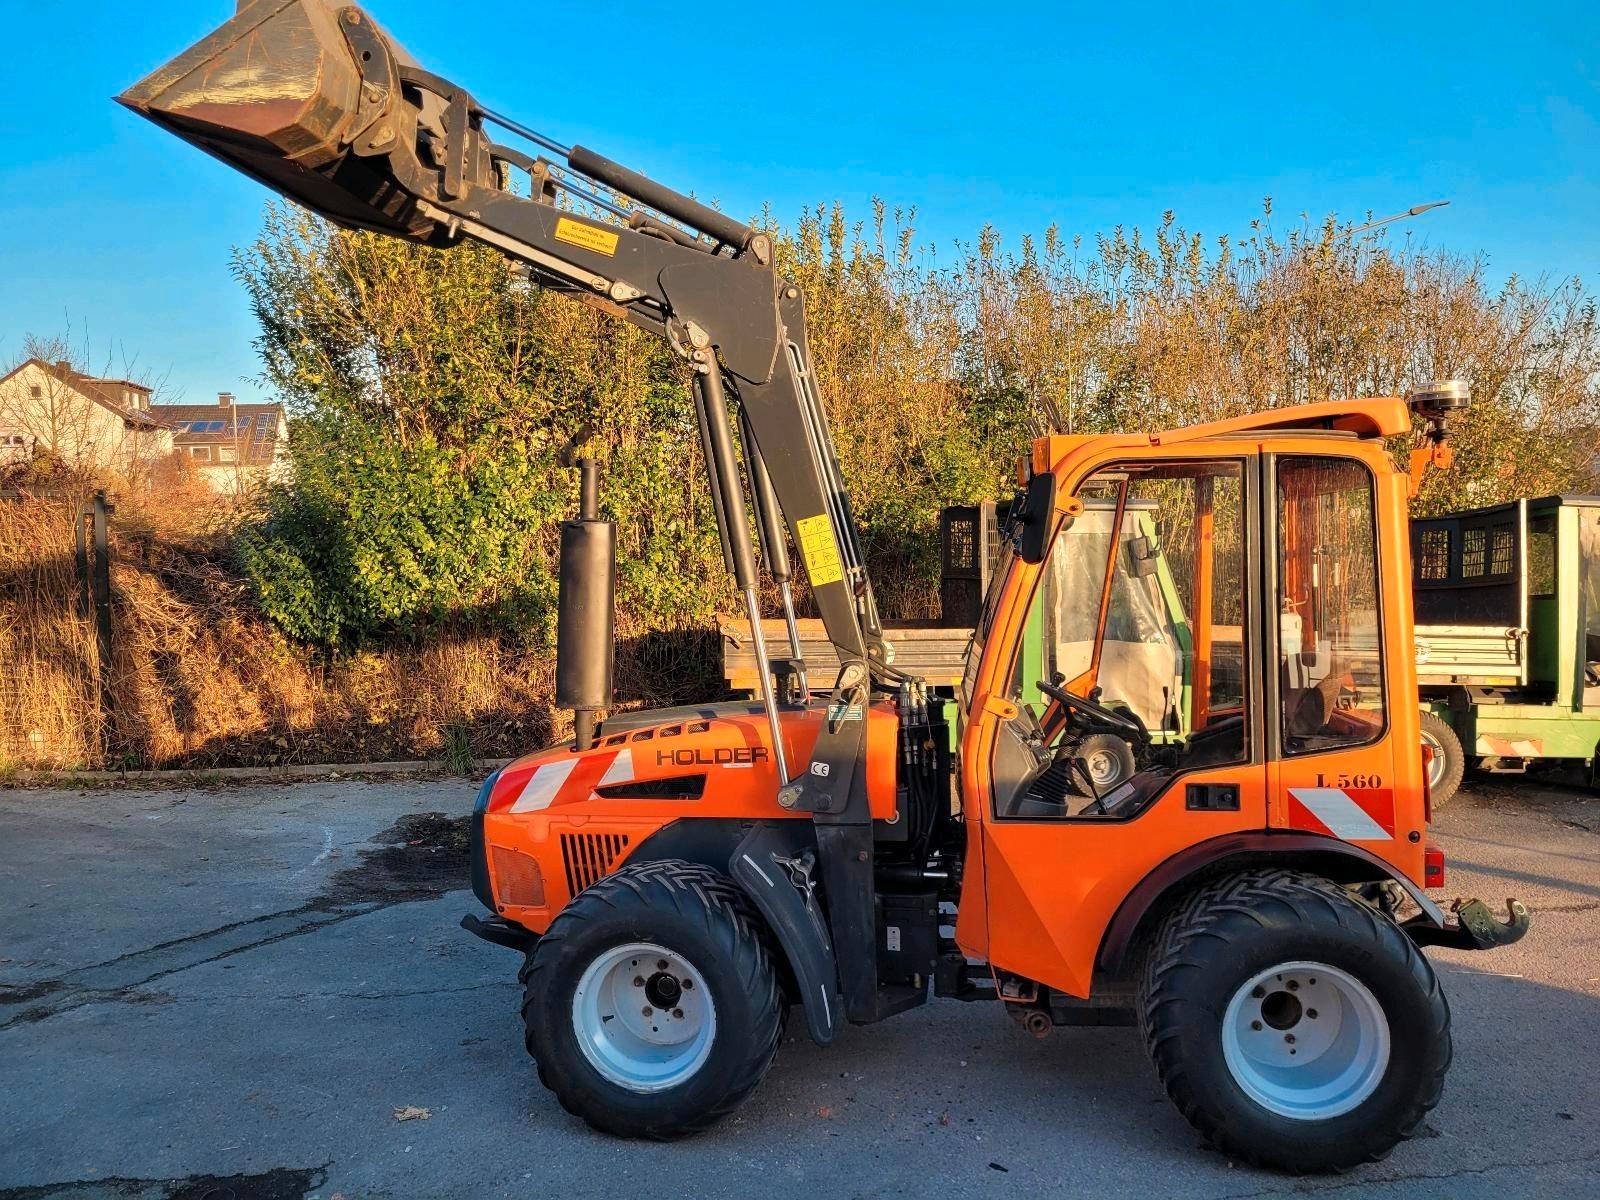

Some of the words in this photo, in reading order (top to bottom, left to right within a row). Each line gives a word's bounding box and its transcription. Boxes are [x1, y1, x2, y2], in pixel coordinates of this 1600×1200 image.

[656, 747, 769, 766] HOLDER
[812, 763, 828, 776] CE
[1316, 773, 1331, 788] L
[1337, 774, 1382, 789] 560
